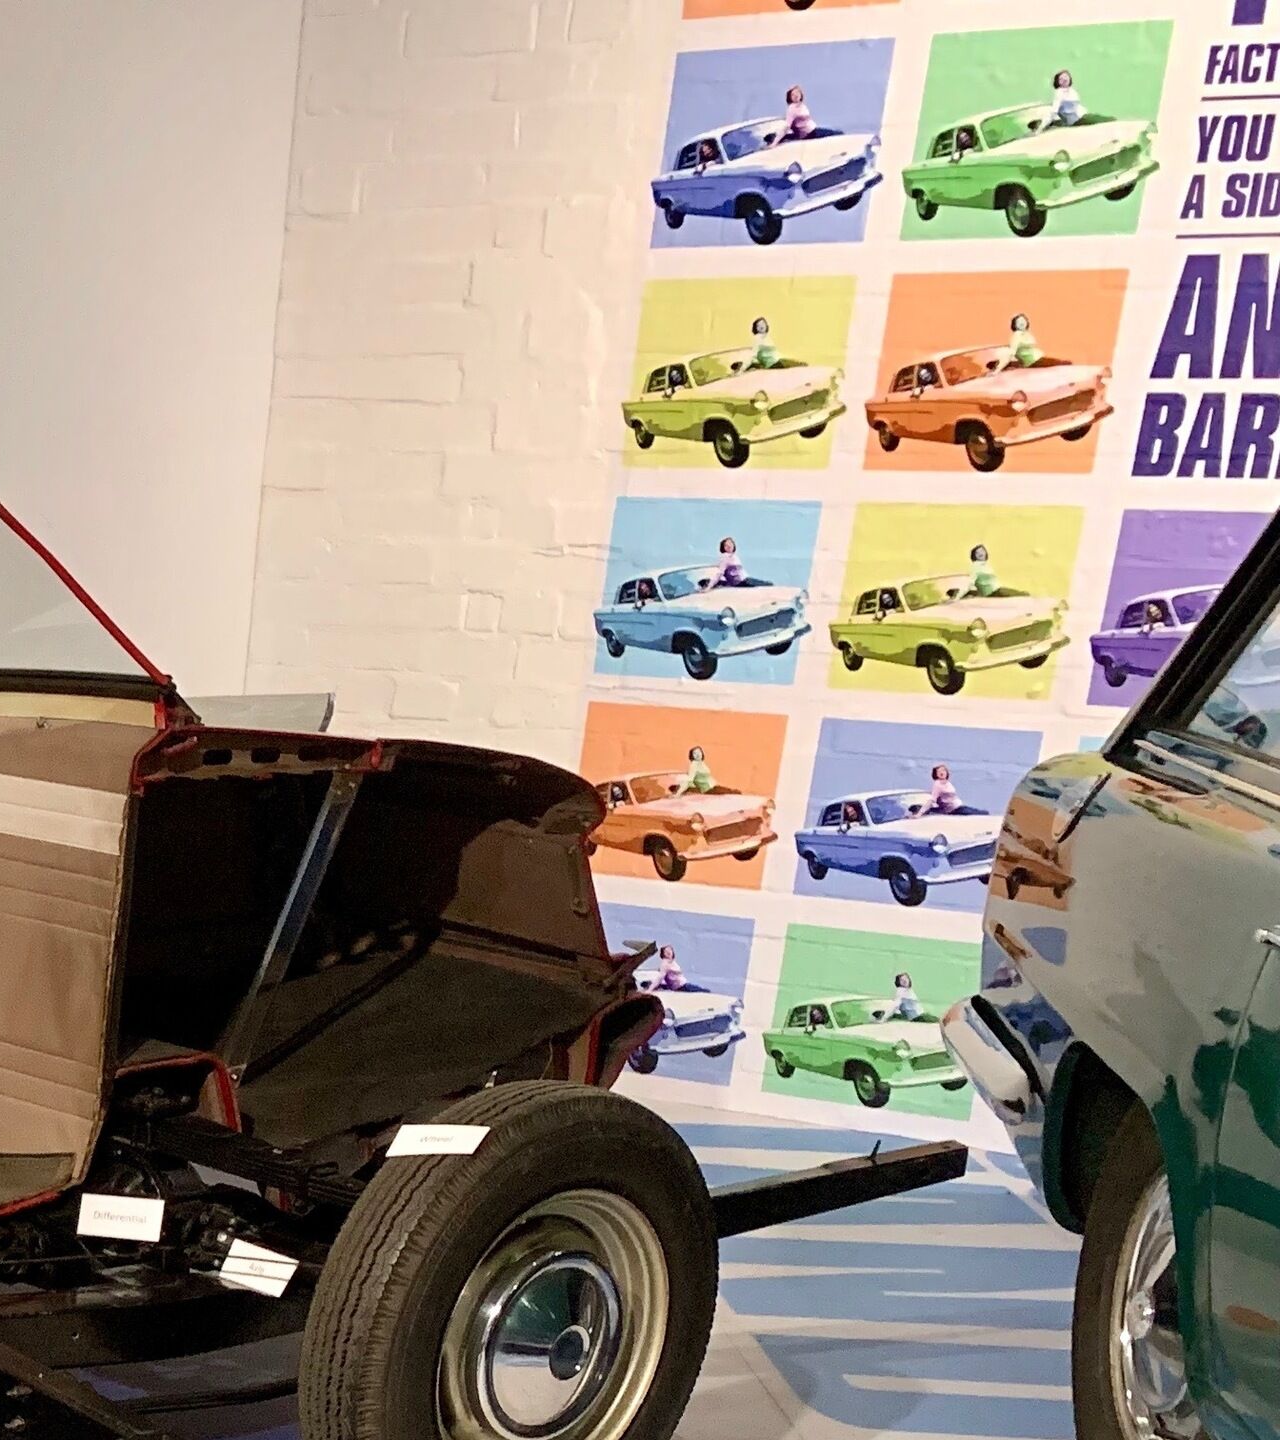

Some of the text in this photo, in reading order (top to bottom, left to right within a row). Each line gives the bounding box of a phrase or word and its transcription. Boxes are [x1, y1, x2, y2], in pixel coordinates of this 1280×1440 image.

[1196, 114, 1276, 163] YOU
[1180, 174, 1206, 220] A
[1131, 392, 1280, 480] BAR
[93, 1209, 147, 1225] Differential
